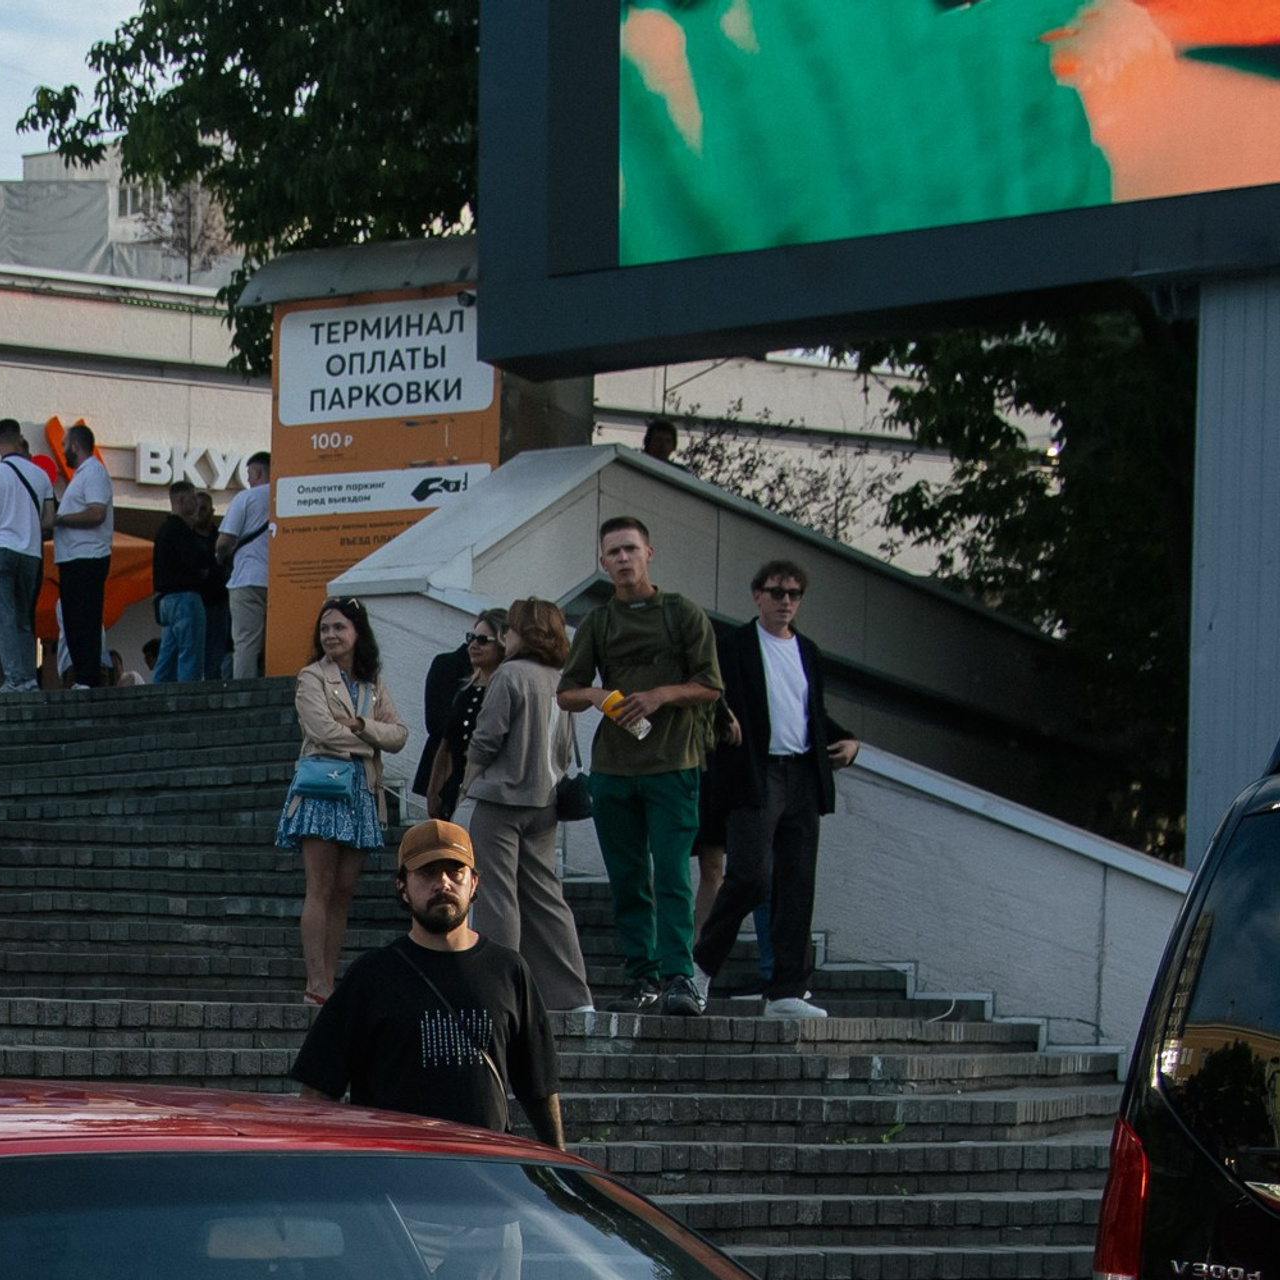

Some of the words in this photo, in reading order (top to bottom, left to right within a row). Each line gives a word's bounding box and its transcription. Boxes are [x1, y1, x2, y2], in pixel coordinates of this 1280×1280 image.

[309, 309, 465, 346] ТЕРМИНАЛ
[325, 344, 447, 378] ОПЛАТЫ
[309, 376, 463, 413] ПАРКОВКИ
[310, 432, 342, 450] 100
[296, 484, 344, 496] Оплатите
[345, 481, 386, 493] паркинг
[296, 497, 326, 508] перед
